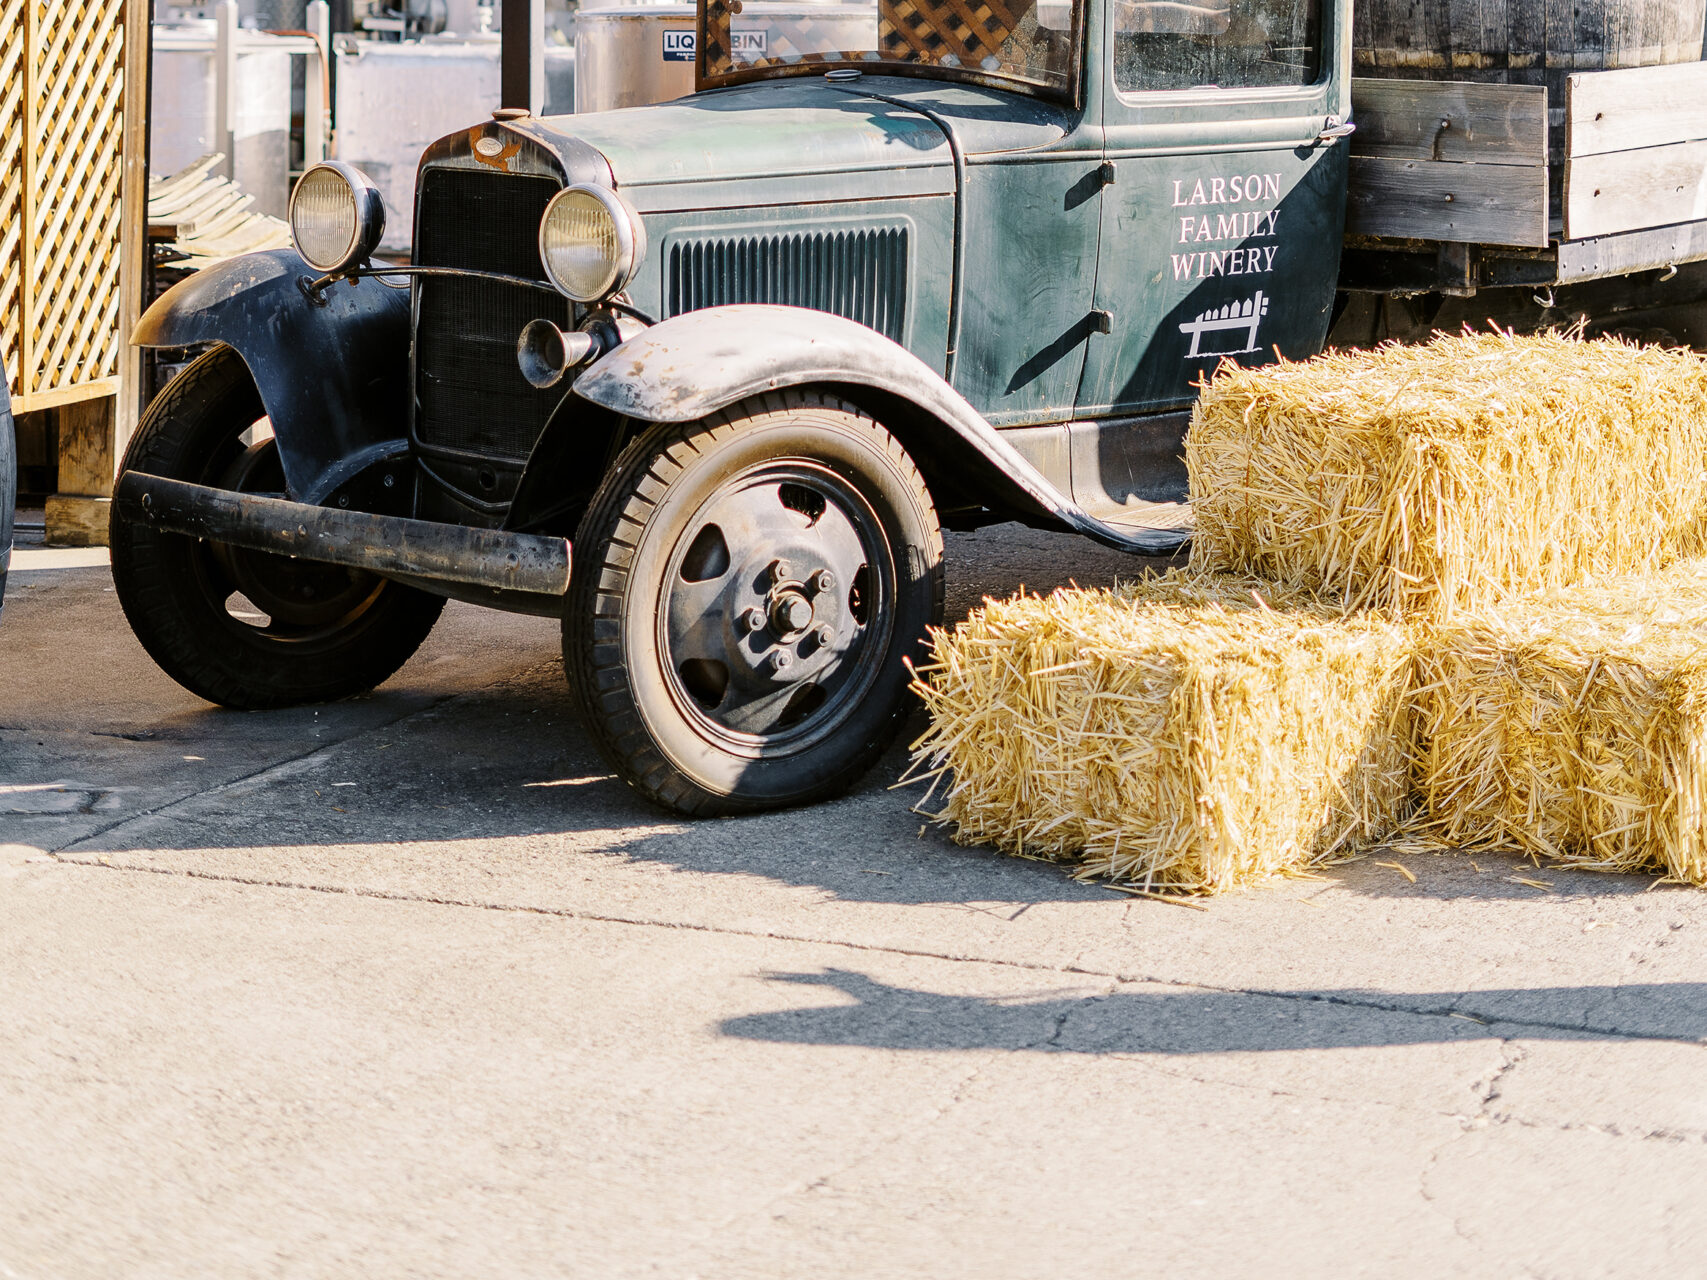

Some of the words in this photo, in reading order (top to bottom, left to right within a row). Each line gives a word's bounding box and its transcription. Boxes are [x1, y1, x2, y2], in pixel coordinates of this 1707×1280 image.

[667, 34, 695, 49] LIQ
[1172, 173, 1282, 207] LARSON
[1178, 210, 1280, 243] FAMILY
[1171, 246, 1279, 280] WINERY
